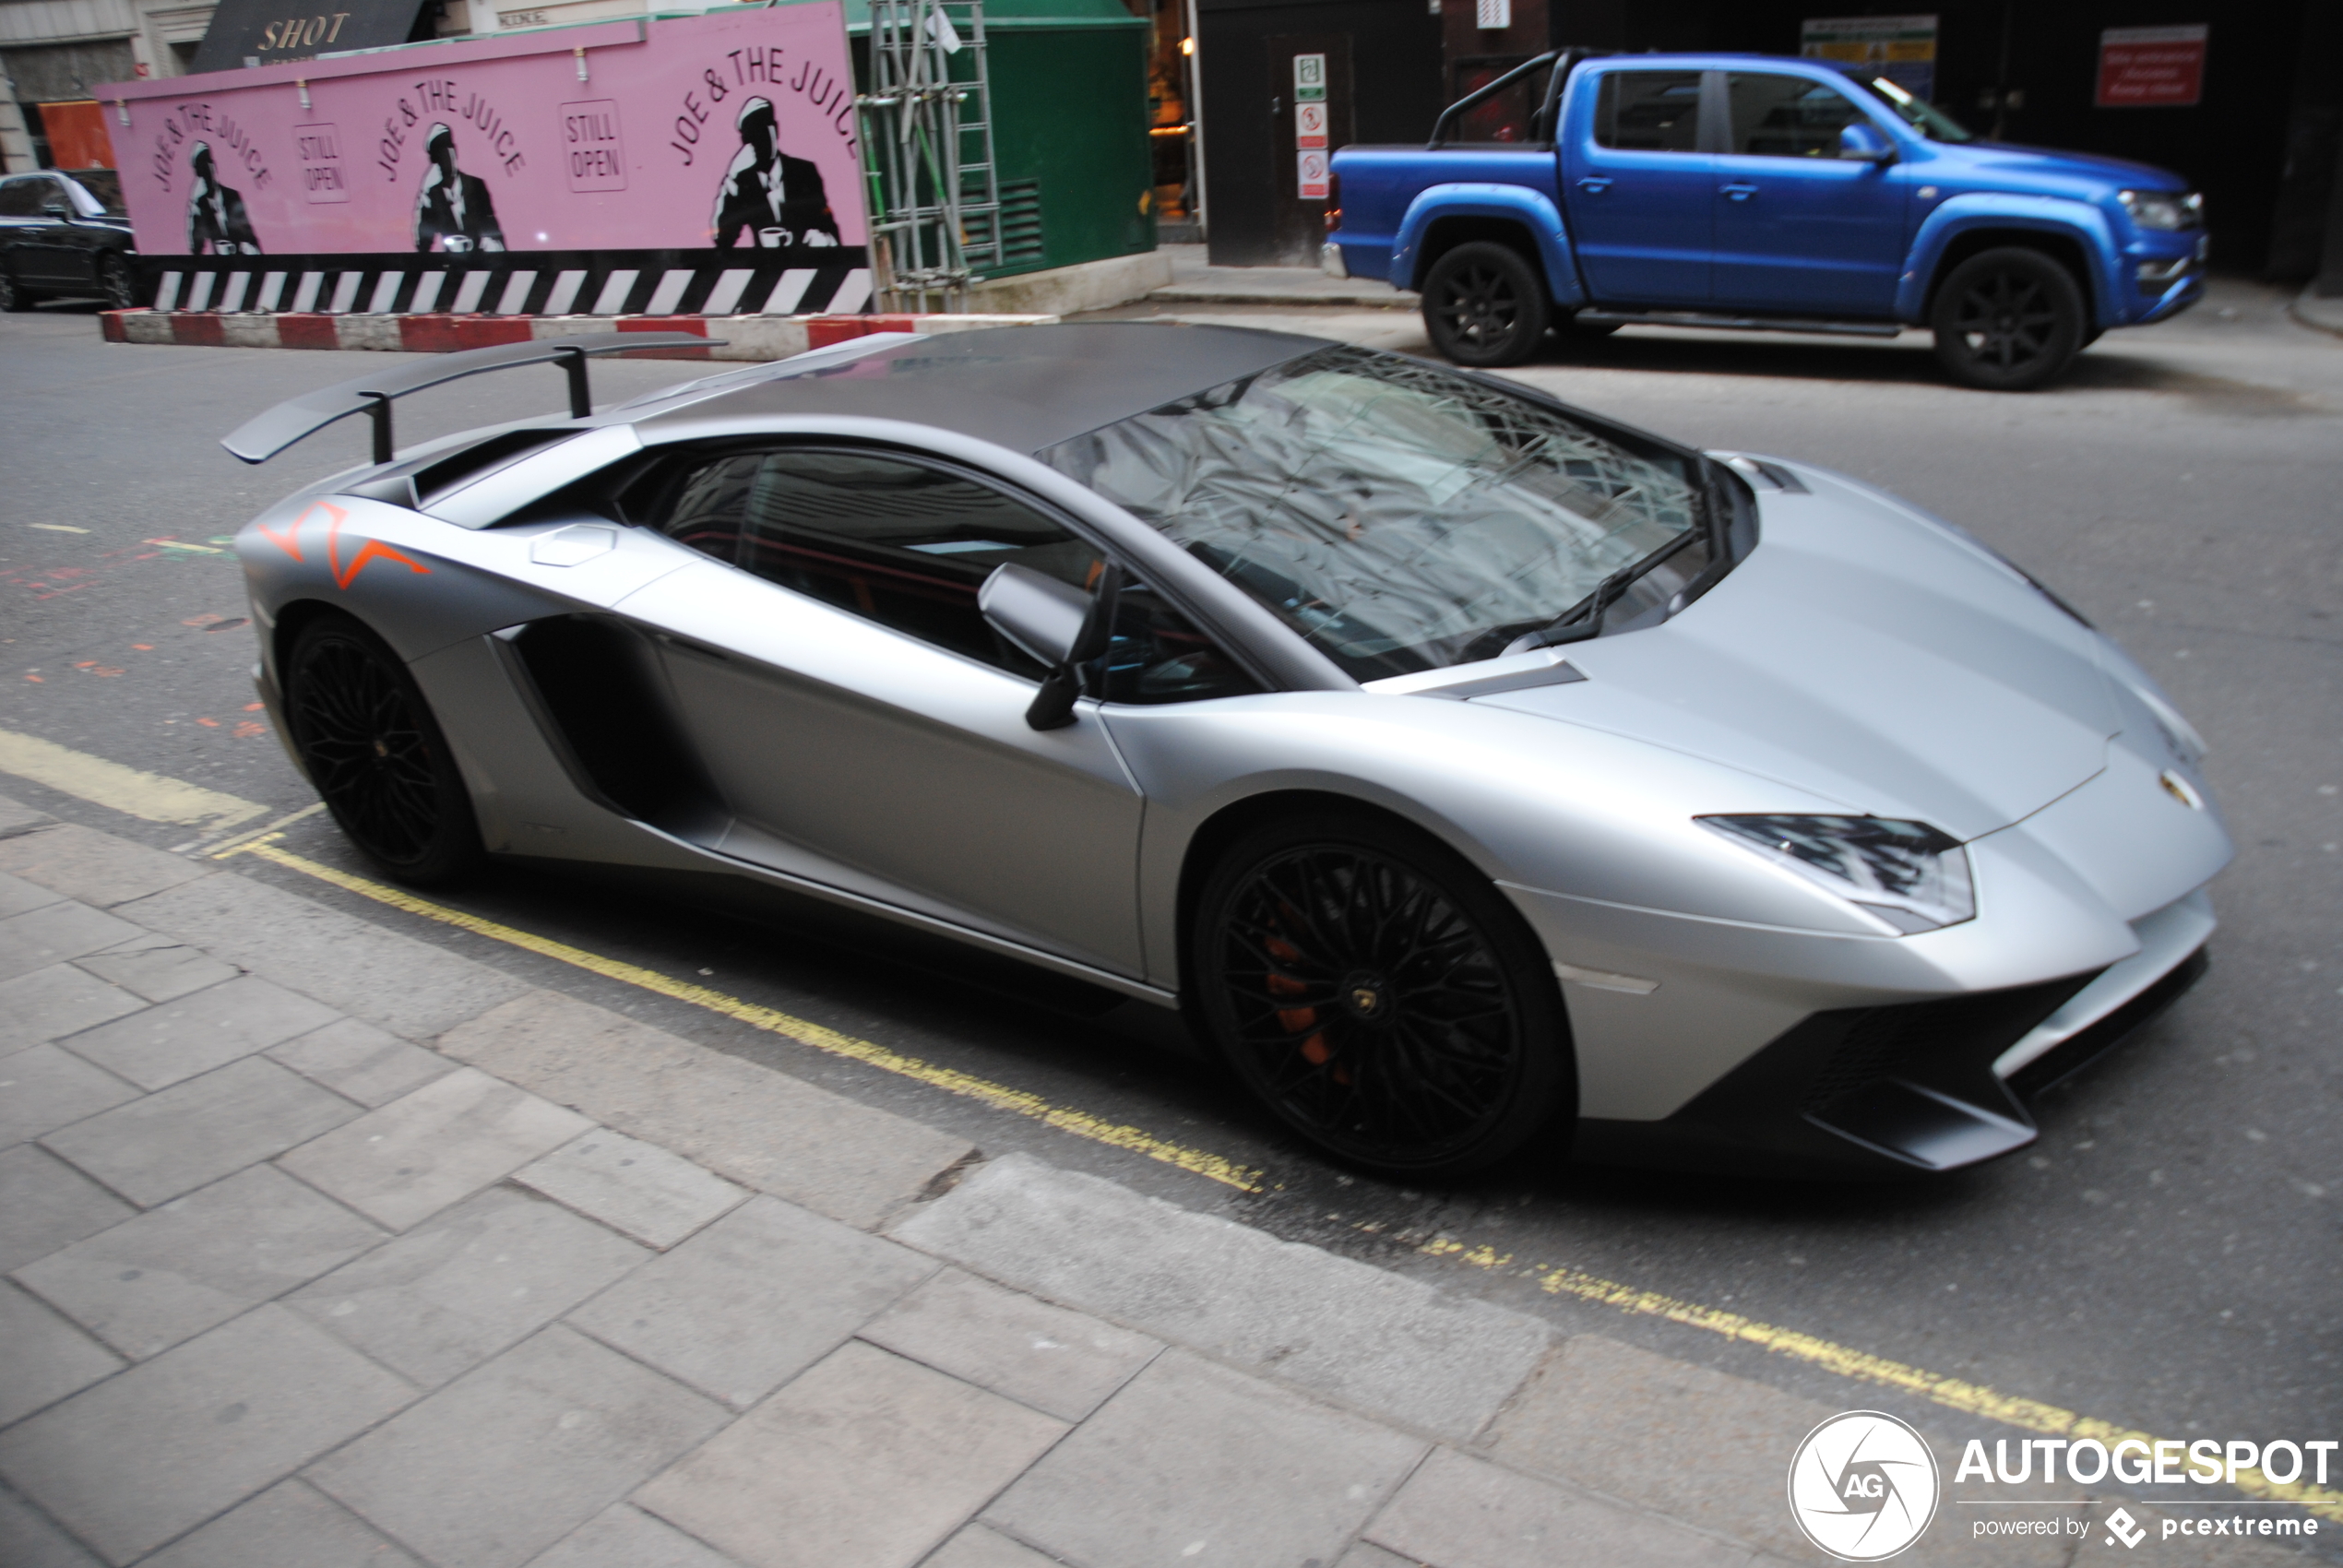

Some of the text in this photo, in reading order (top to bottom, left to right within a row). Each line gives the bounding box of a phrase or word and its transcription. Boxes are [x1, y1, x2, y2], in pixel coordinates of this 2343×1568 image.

[257, 13, 351, 51] SHOT
[671, 91, 709, 166] JOE
[704, 68, 730, 102] &
[727, 46, 783, 86] THE
[377, 79, 526, 182] JOE & THE JUICE
[565, 113, 615, 142] STILL
[152, 102, 272, 192] JOE & THE JUICE
[299, 136, 339, 160] STILL
[571, 149, 620, 177] OPEN
[305, 167, 344, 191] OPEN
